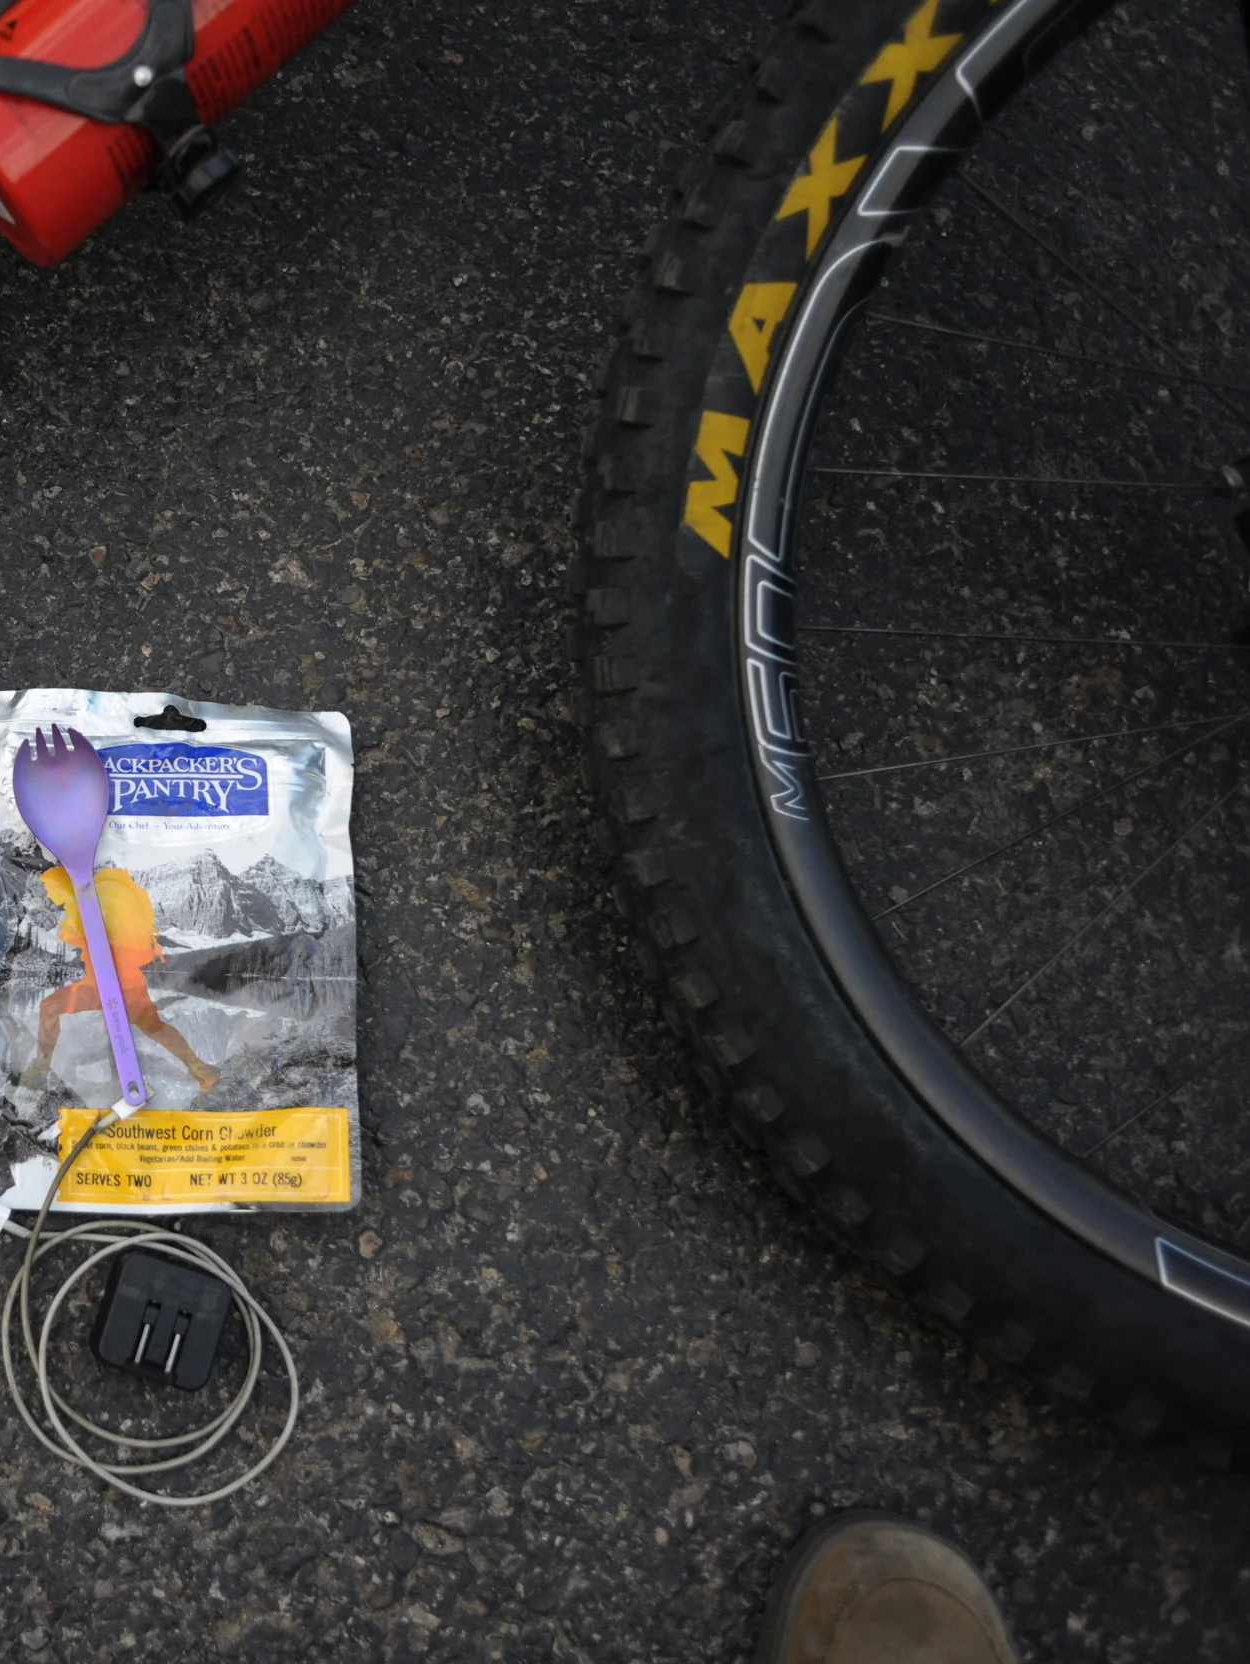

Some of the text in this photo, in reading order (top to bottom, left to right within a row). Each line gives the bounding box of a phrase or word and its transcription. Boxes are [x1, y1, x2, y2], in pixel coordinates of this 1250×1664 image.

[679, 0, 963, 559] MAXX
[104, 756, 263, 791] ACKPACKER'S
[110, 778, 235, 814] PANTRY
[129, 821, 149, 830] Chef
[164, 822, 183, 830] Your
[188, 822, 231, 830] Adventure
[108, 1123, 177, 1140] Southwest
[181, 1125, 214, 1141] Corn
[162, 1144, 183, 1153] green
[220, 1143, 250, 1152] potatoes
[268, 1140, 295, 1149] creay
[224, 1153, 245, 1162] Water
[76, 1171, 303, 1188] SERVES TWO NET WT 3 OZ (85g)
